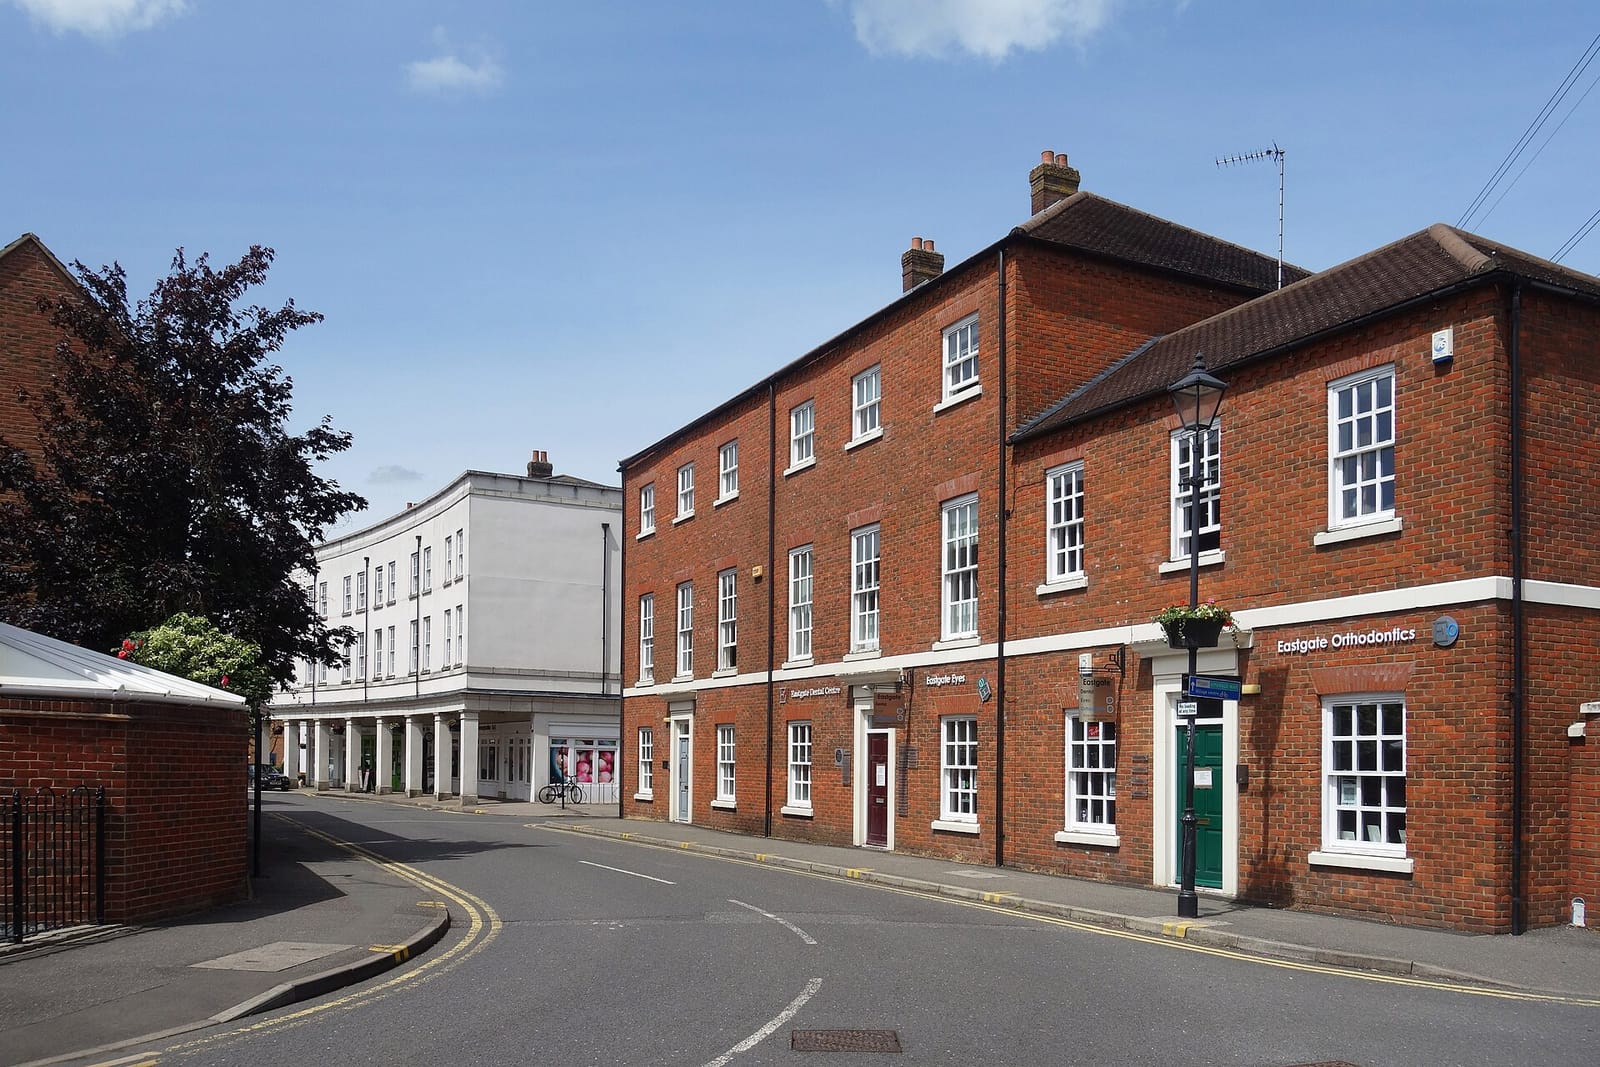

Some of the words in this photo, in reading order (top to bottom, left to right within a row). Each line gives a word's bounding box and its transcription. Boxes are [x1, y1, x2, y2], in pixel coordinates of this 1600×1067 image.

[1277, 636, 1328, 653] Eastgate
[1331, 628, 1416, 647] Orthodontics
[926, 675, 950, 686] Eastgate
[952, 673, 965, 685] Eyes
[1083, 678, 1111, 688] Eastgate
[791, 690, 809, 699] Eastgate
[810, 687, 824, 696] Dental
